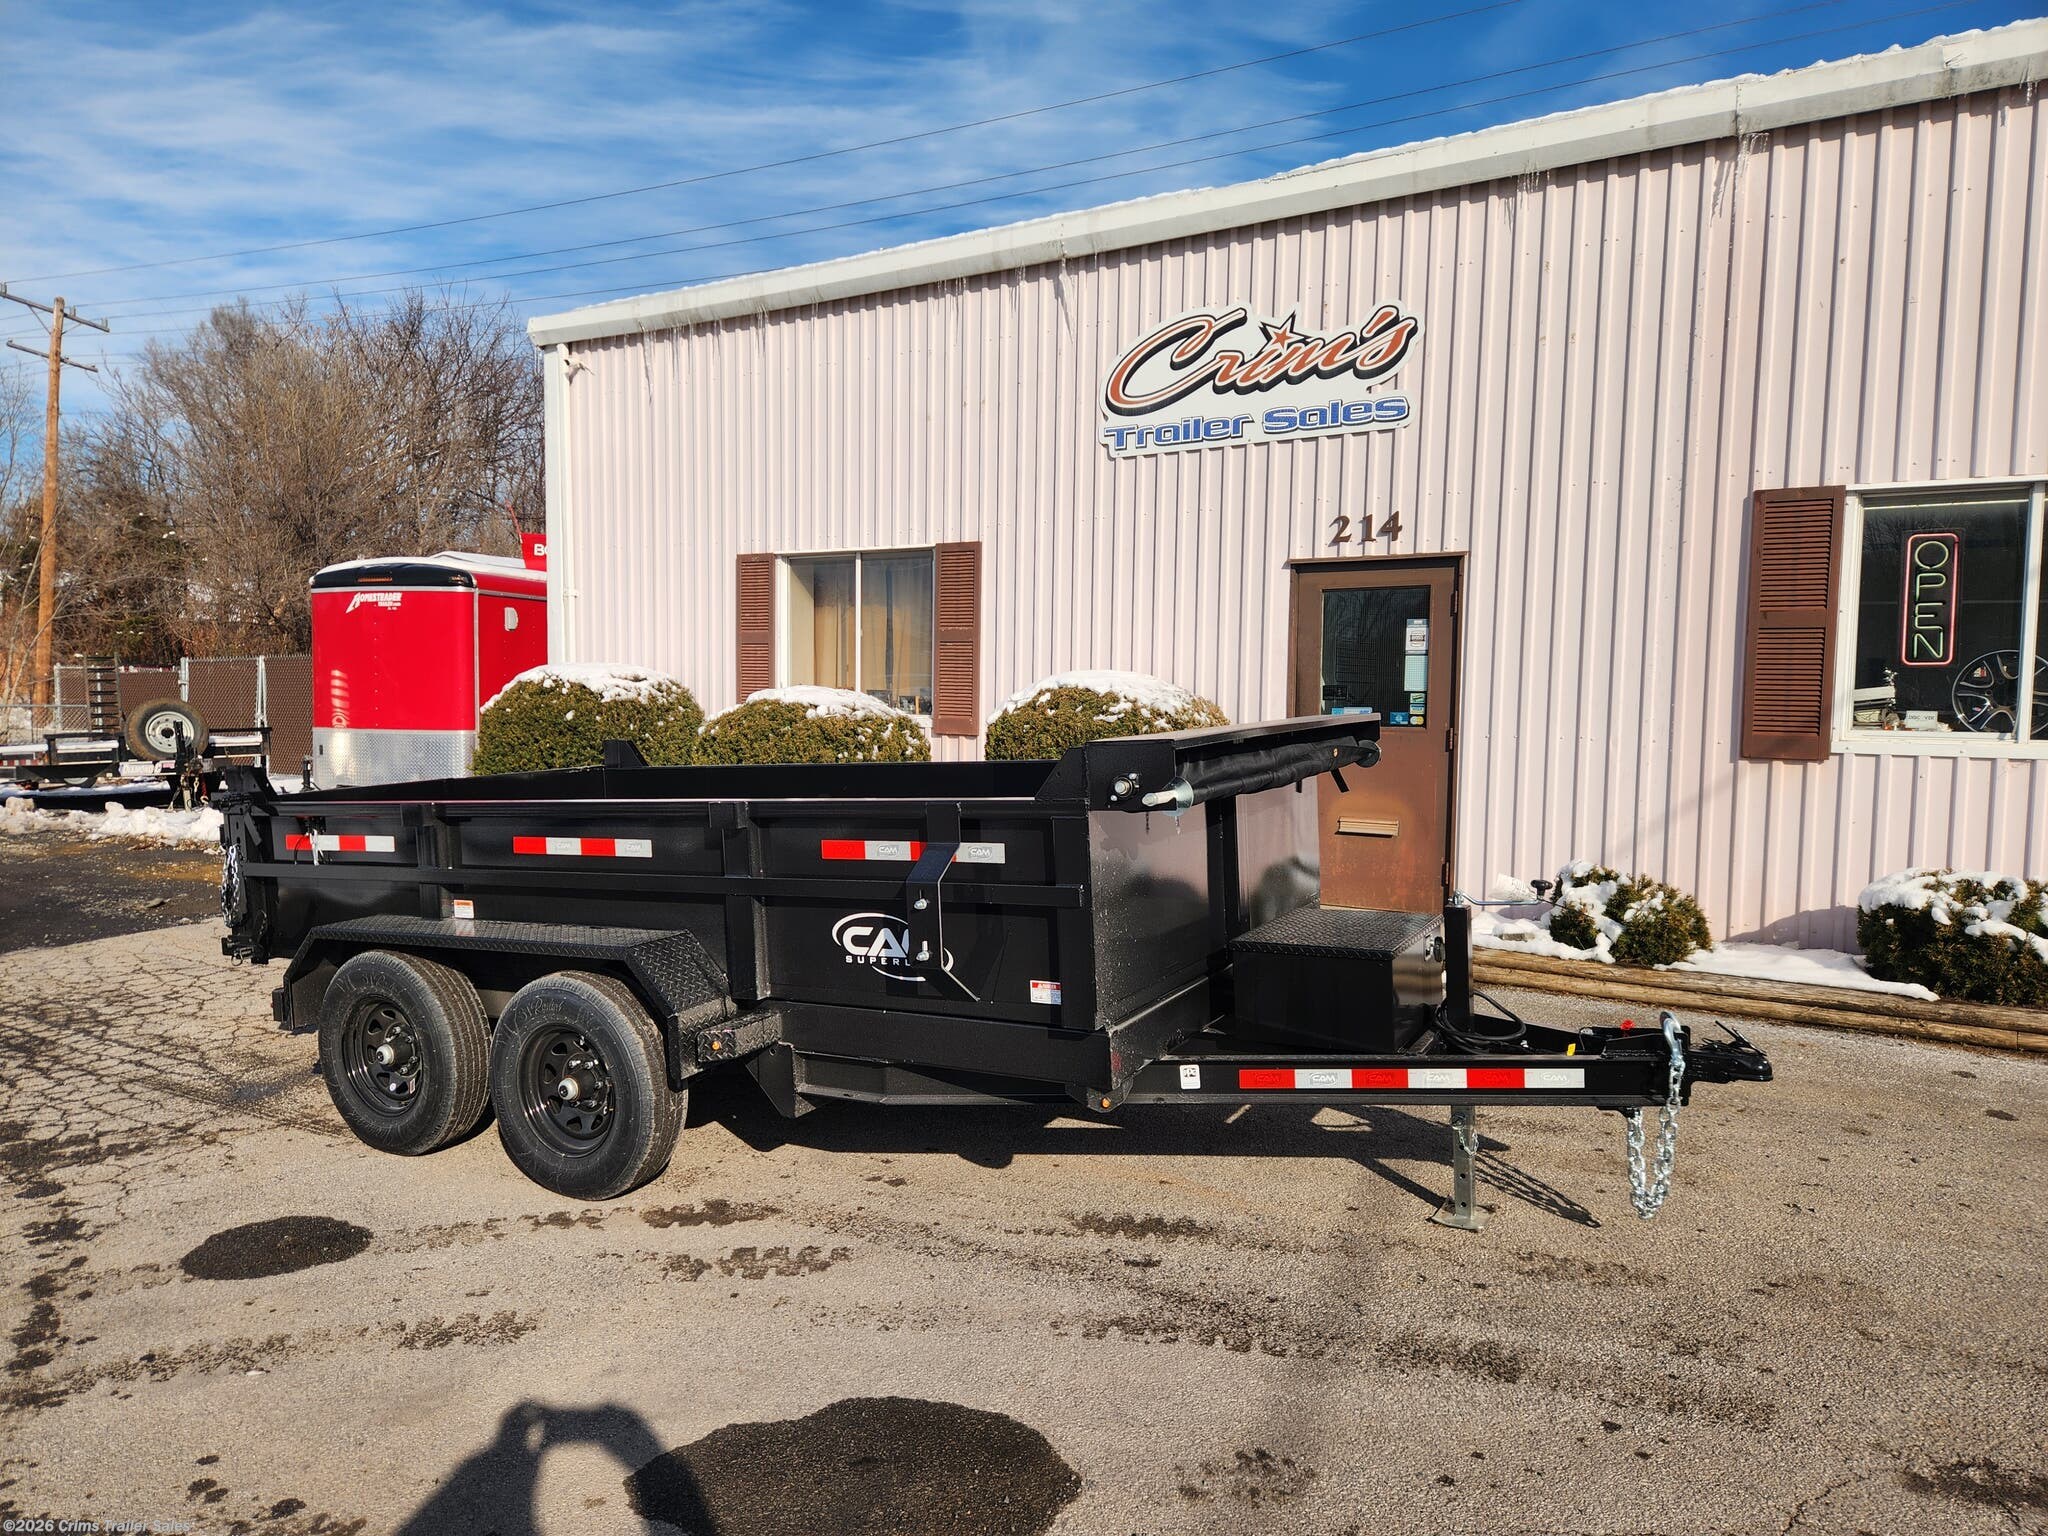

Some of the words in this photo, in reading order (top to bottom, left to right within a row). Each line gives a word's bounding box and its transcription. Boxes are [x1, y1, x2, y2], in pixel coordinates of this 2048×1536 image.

[1105, 306, 1418, 417] Crim's
[1104, 414, 1254, 450] Trailer
[1262, 396, 1410, 434] Sales
[1330, 511, 1403, 545] 214
[1914, 540, 1949, 659] OPEN
[969, 848, 991, 856] CAM
[842, 926, 910, 958] CA
[845, 955, 911, 967] SUPERL
[1311, 1073, 1336, 1082] CAM
